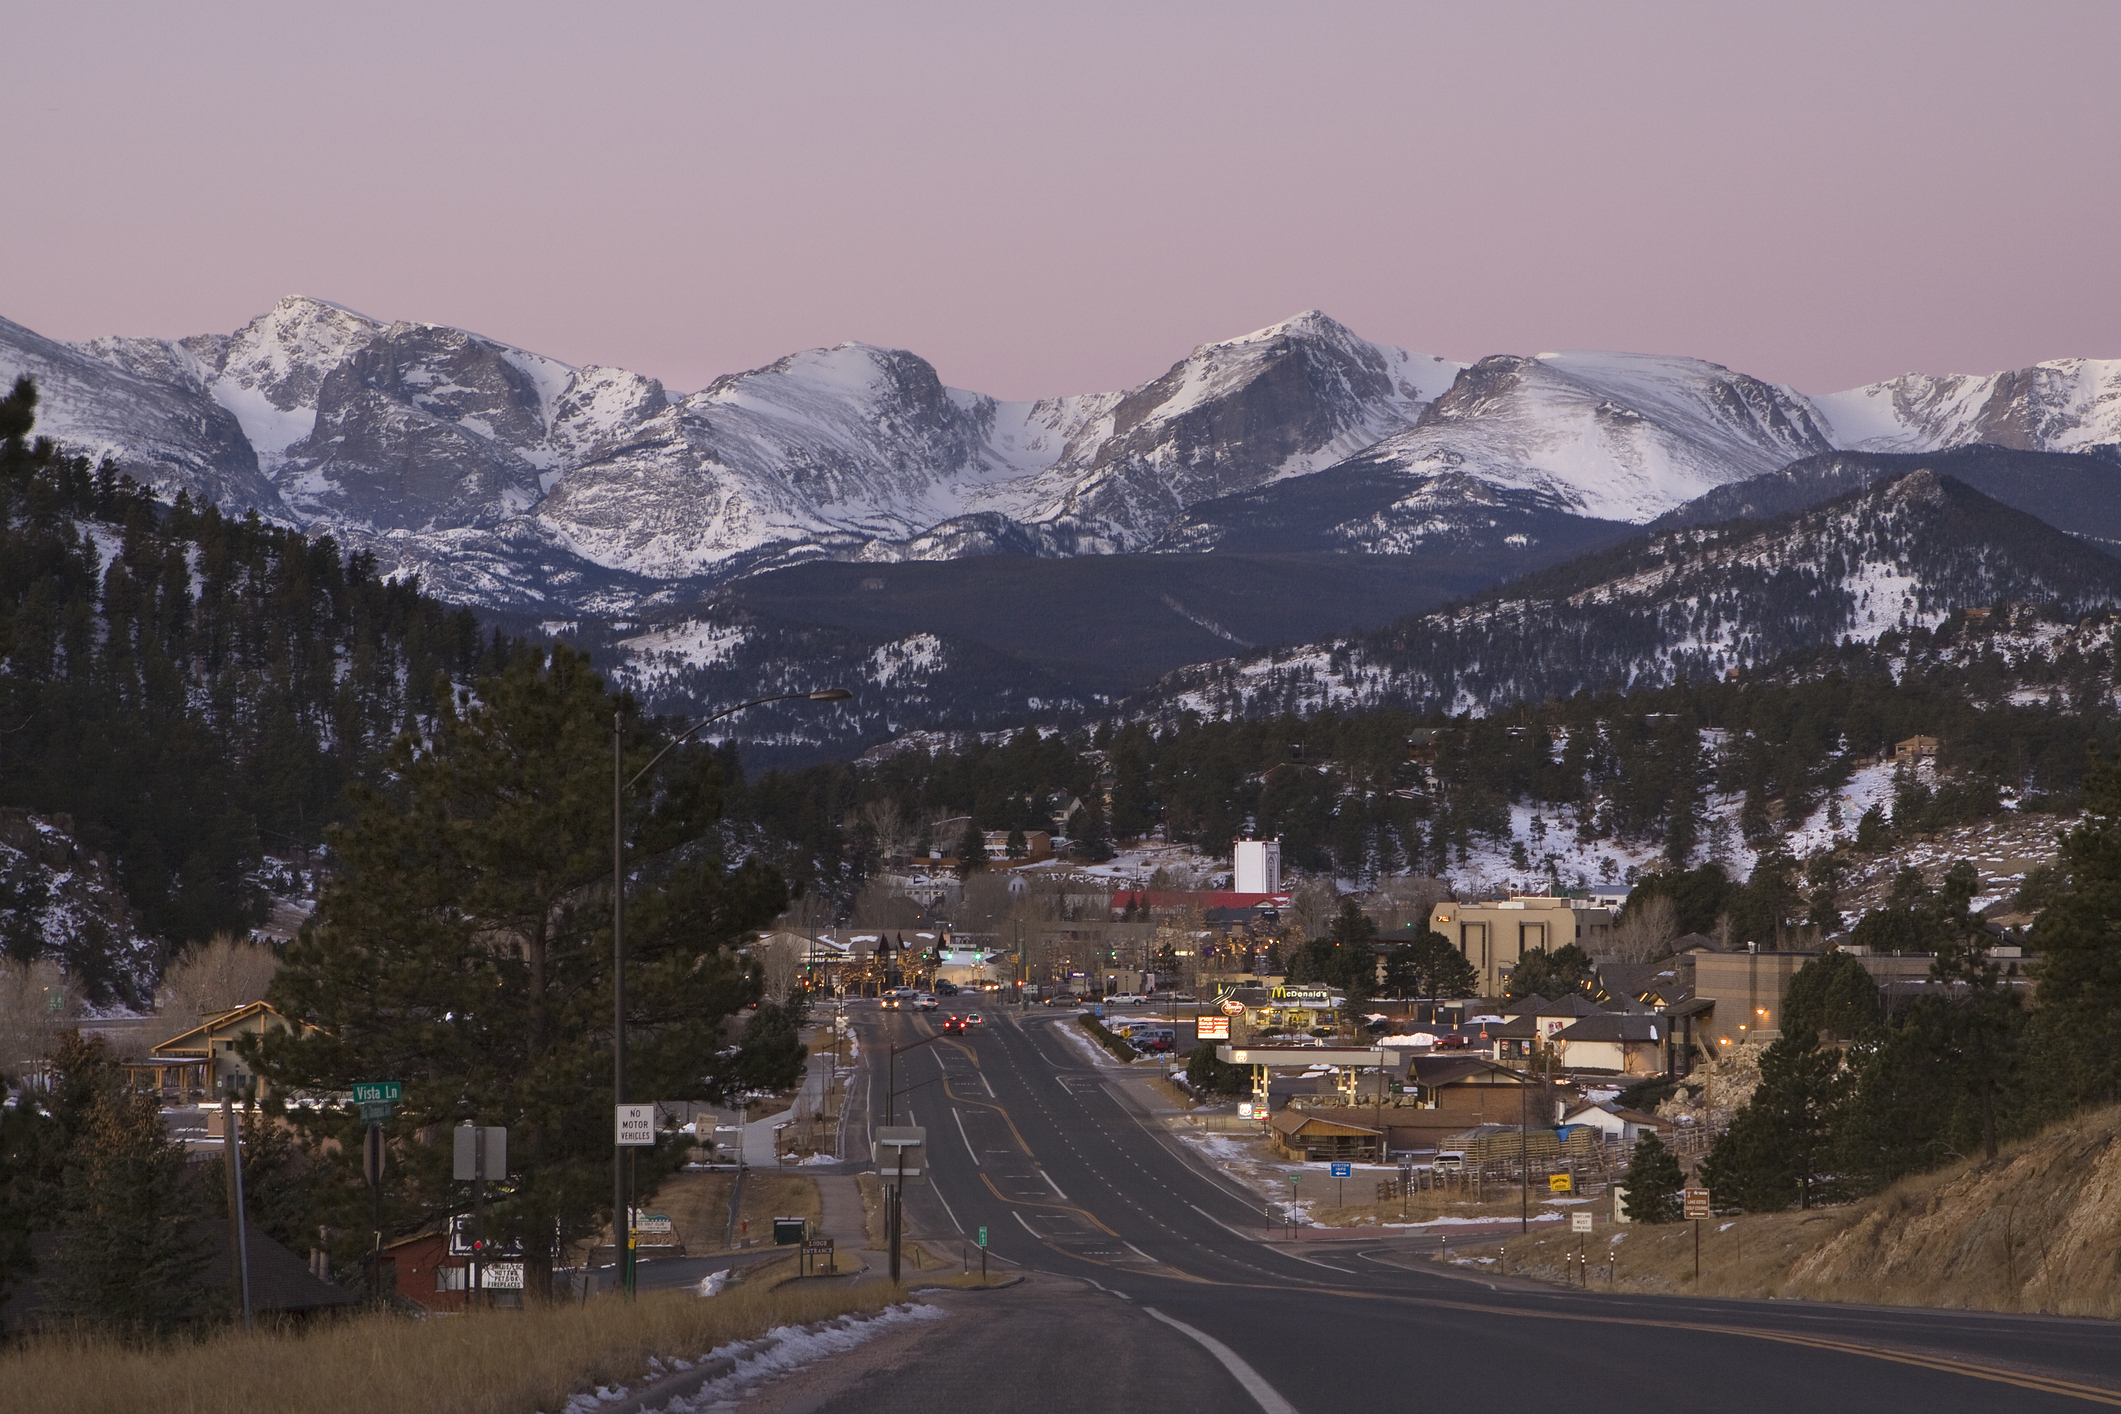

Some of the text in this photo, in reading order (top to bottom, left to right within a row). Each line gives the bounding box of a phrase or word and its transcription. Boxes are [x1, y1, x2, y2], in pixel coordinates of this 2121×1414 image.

[1272, 986, 1327, 998] McDonald's
[357, 1085, 397, 1100] Vista Ln
[630, 1109, 641, 1118] NO
[622, 1121, 648, 1129] MOTOR
[621, 1132, 650, 1140] VEHICLES
